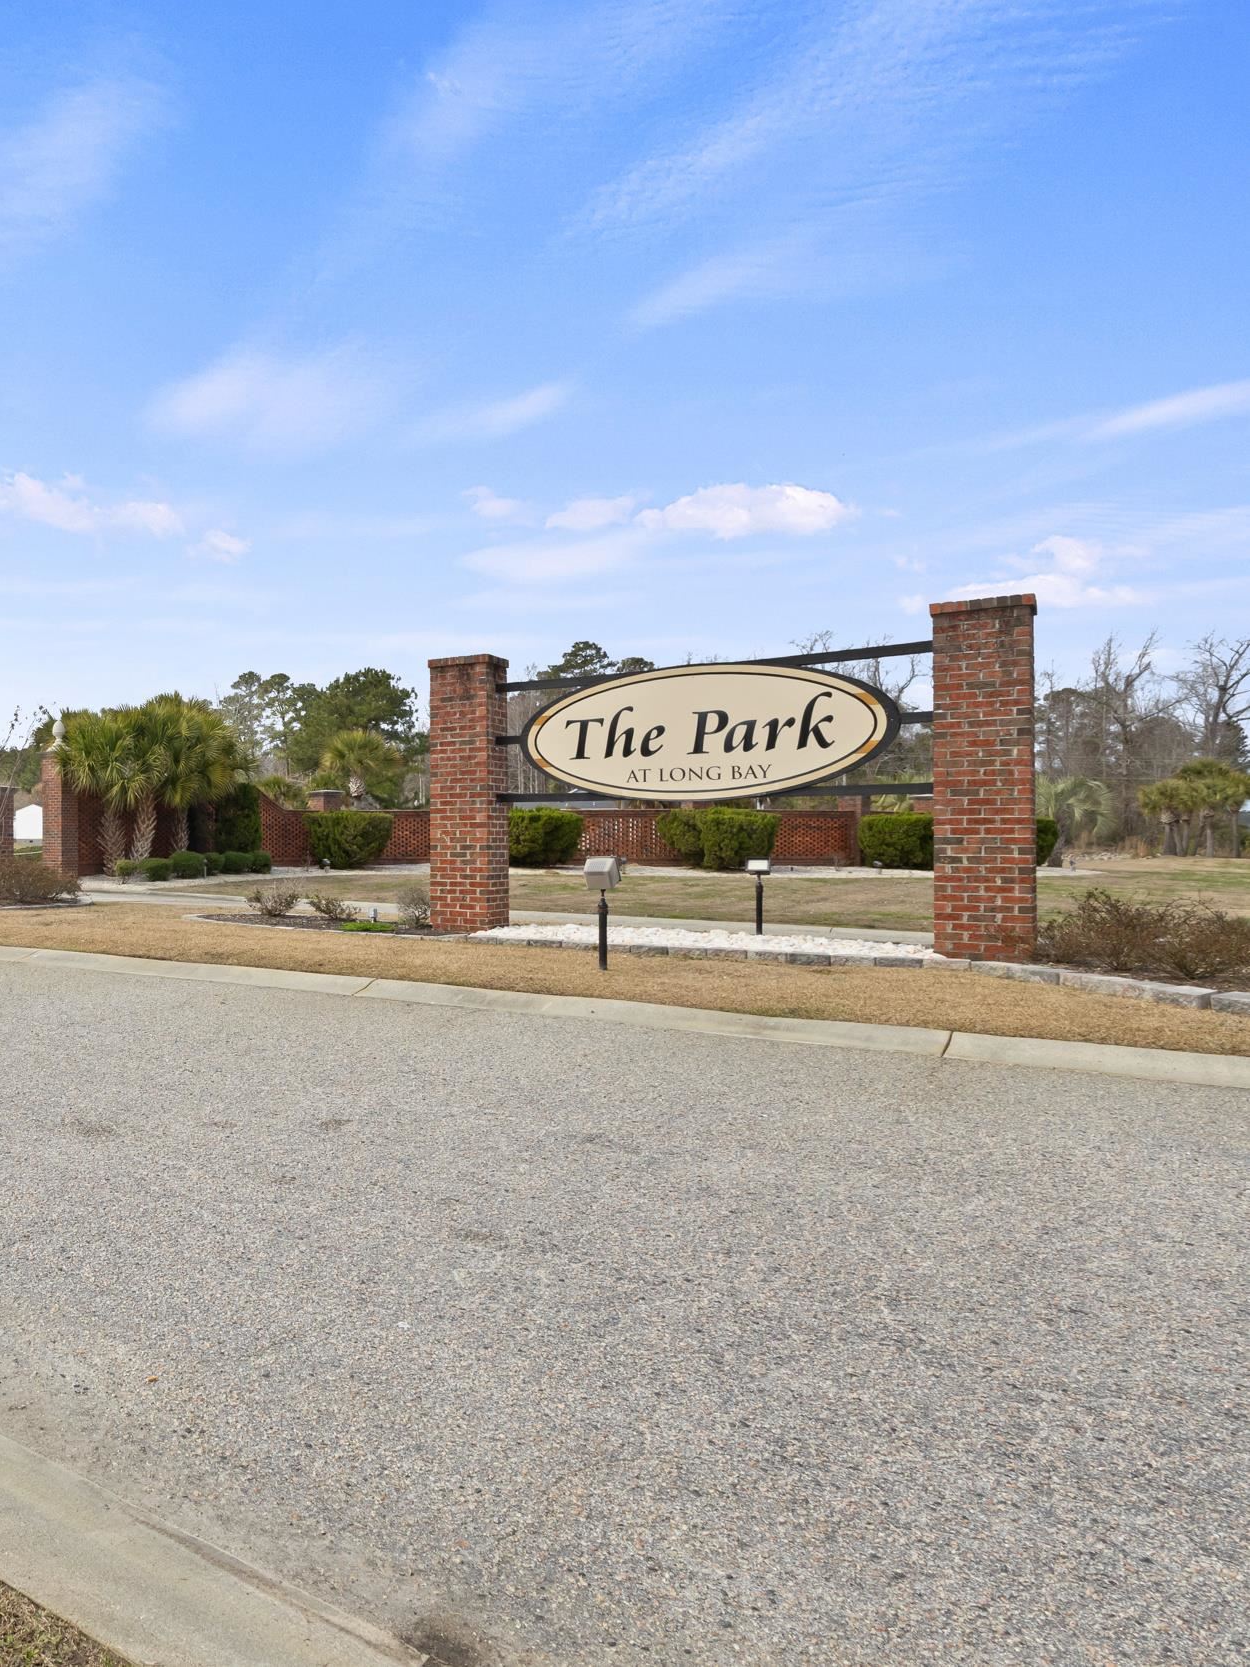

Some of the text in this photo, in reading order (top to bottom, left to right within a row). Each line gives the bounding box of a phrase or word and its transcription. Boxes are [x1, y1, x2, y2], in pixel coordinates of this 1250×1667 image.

[565, 691, 836, 760] The Park
[626, 764, 772, 783] AT LONG BAY
